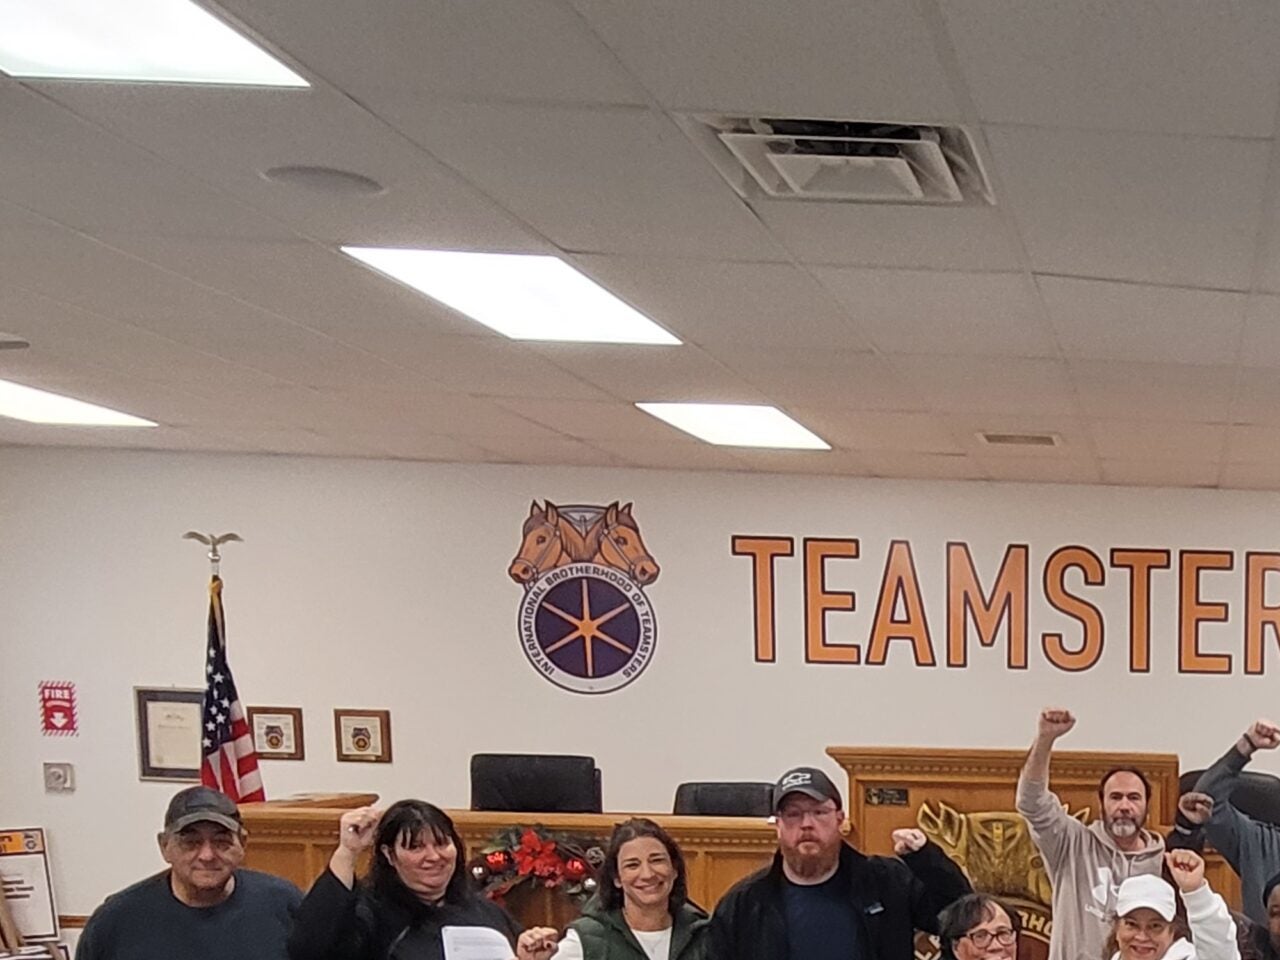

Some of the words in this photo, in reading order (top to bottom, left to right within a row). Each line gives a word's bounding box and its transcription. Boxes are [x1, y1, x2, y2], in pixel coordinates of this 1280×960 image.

[546, 565, 633, 594] BROTHERHOOD
[631, 592, 646, 610] OF
[523, 586, 555, 676] INTERNATIONAL
[622, 609, 653, 678] TEAMSTERS
[44, 689, 70, 699] FIRE
